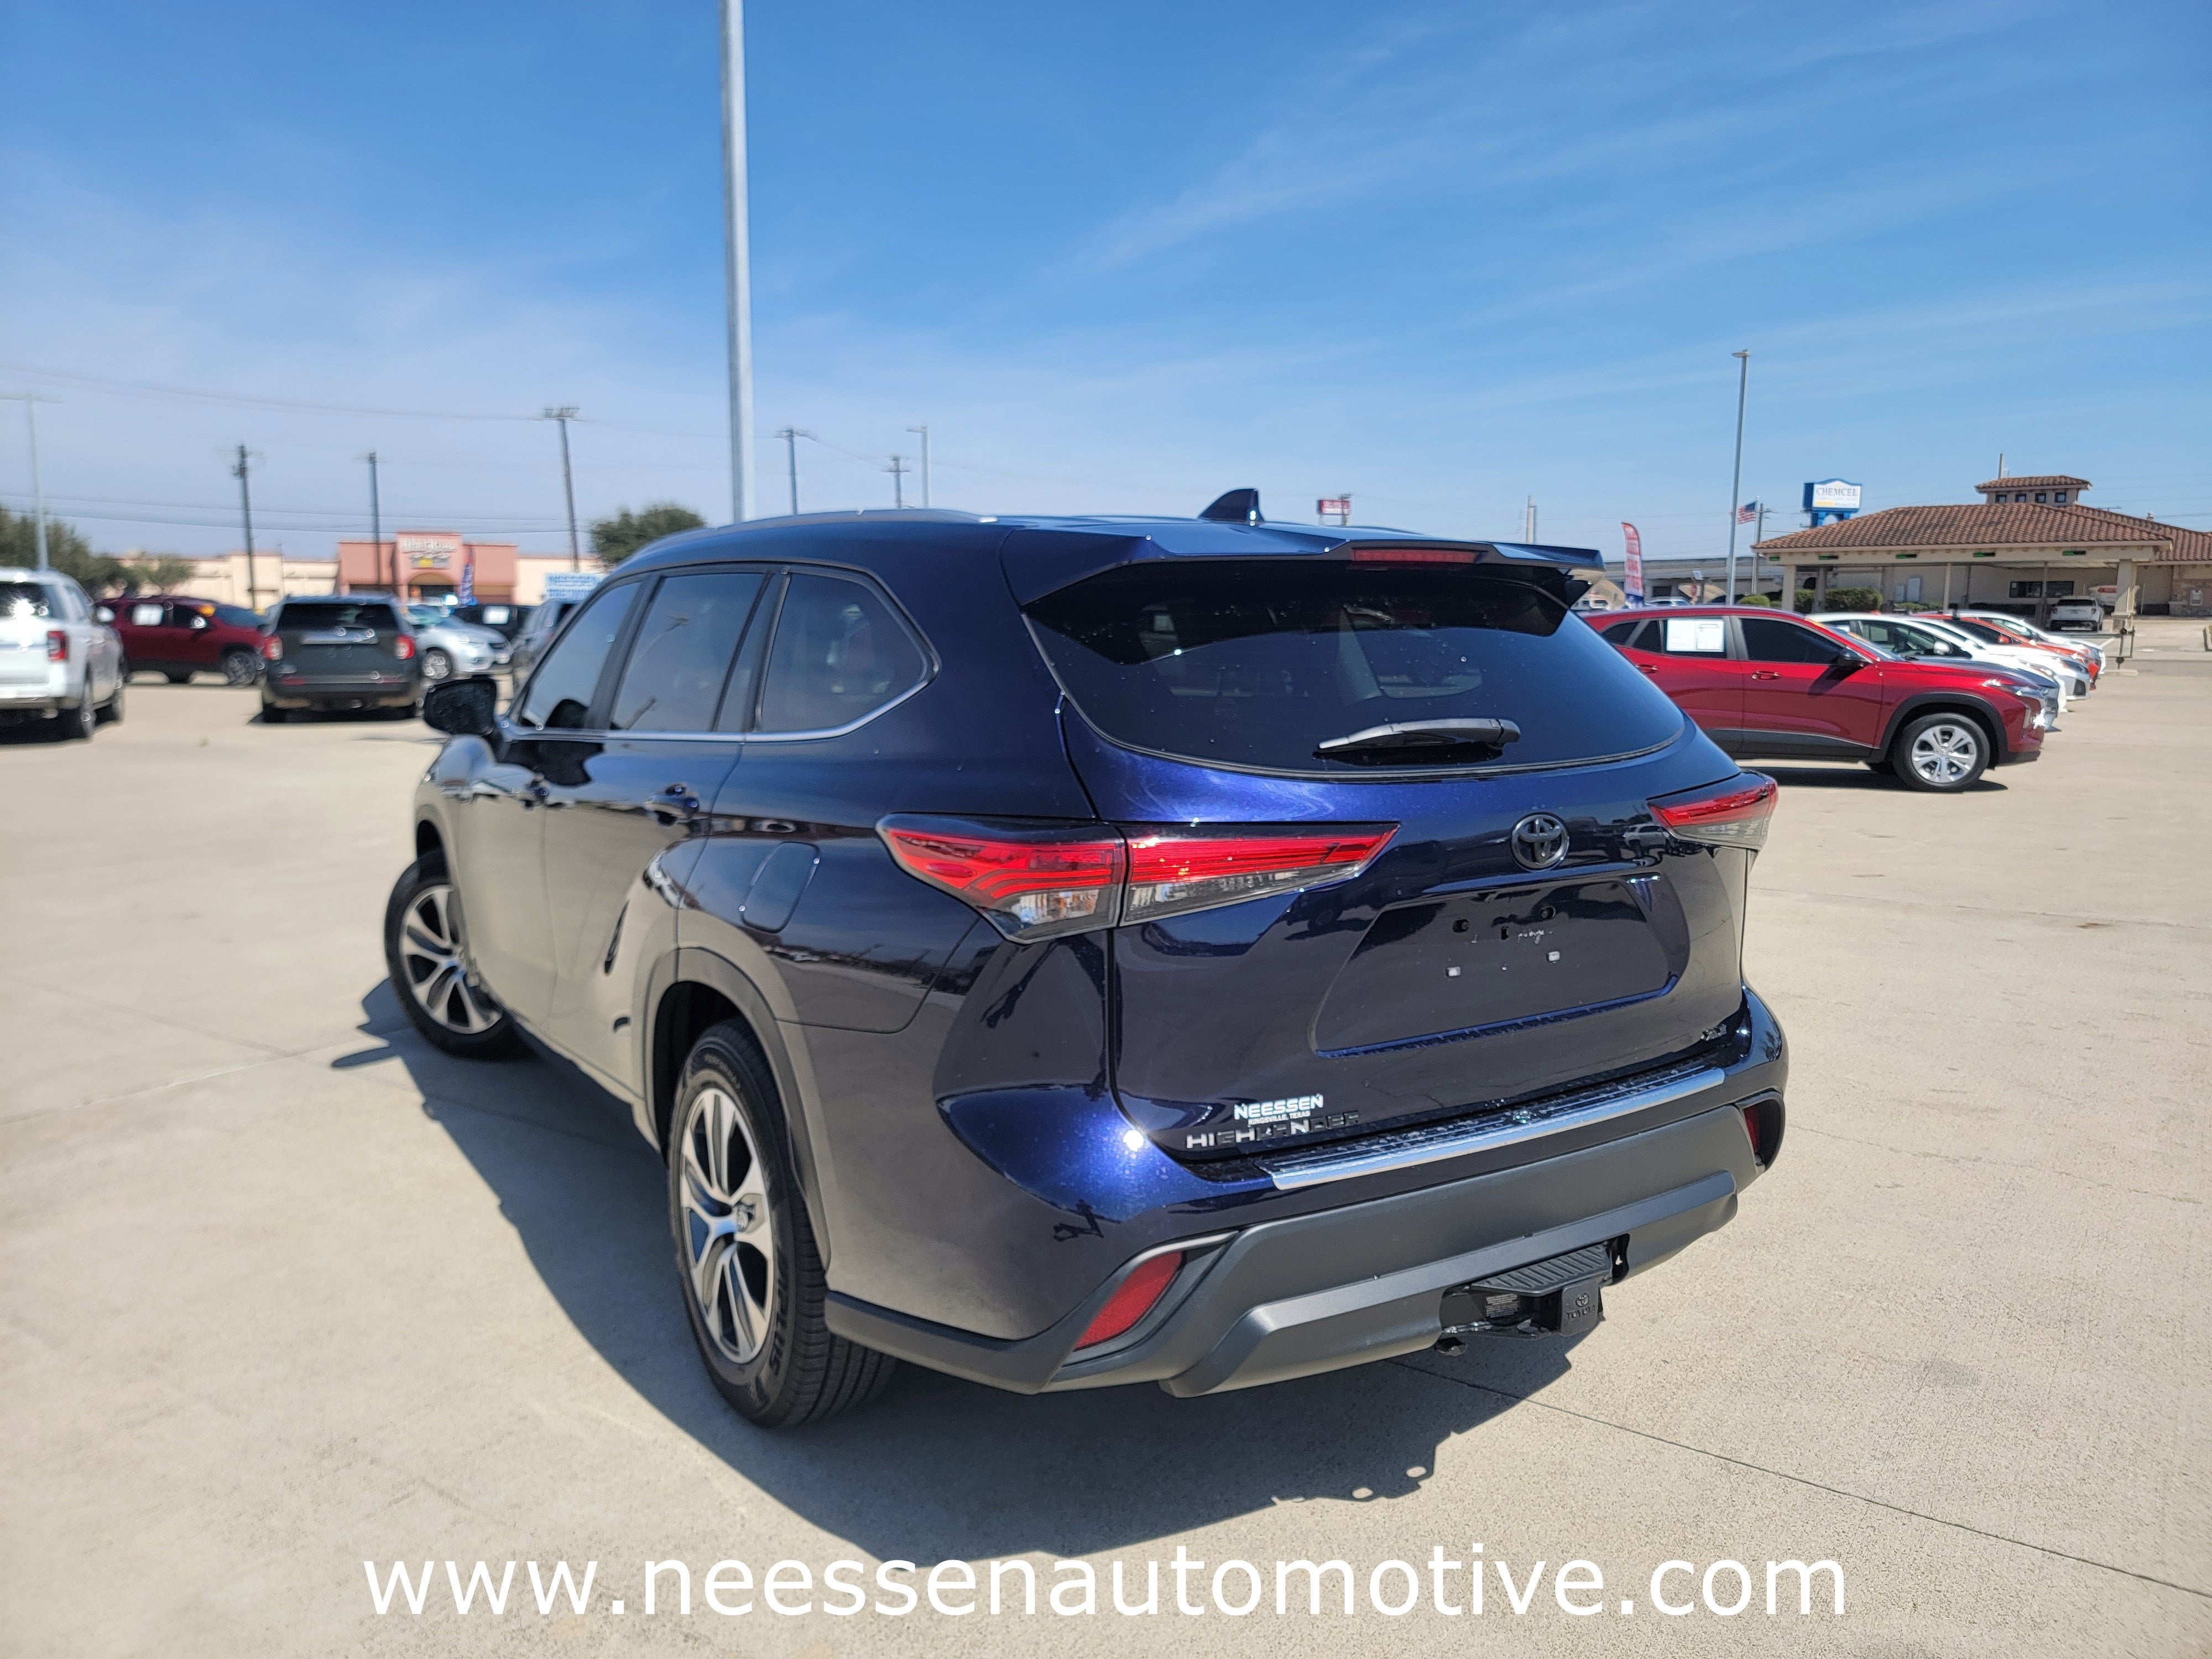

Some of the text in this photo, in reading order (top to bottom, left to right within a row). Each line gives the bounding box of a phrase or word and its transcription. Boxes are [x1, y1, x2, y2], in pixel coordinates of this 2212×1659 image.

[1234, 1093, 1323, 1120] NEESSEN
[1289, 1110, 1311, 1119] TEXAS
[1566, 1305, 1595, 1319] TOYOTA
